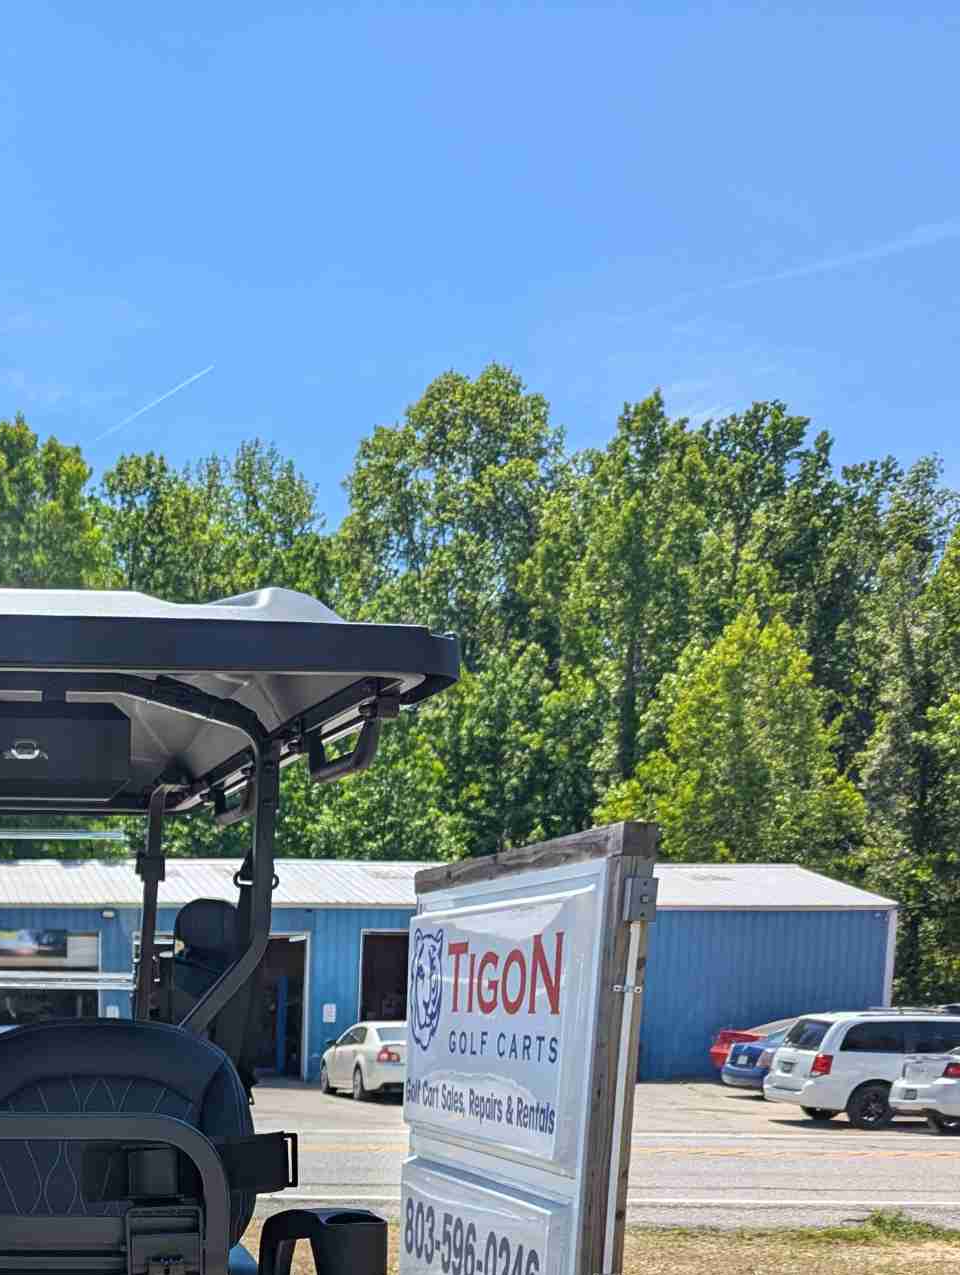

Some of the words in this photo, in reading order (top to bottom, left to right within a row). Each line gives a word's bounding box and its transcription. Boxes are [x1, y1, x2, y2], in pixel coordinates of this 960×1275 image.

[448, 932, 564, 1015] TIGON
[448, 1030, 488, 1056] GOLF
[497, 1032, 558, 1064] CARTS
[406, 1078, 421, 1105] Golf
[422, 1080, 439, 1110] Cart
[441, 1083, 465, 1117] Sales,
[469, 1088, 503, 1125] Repairs
[506, 1096, 514, 1125] &
[516, 1097, 555, 1135] Rentals
